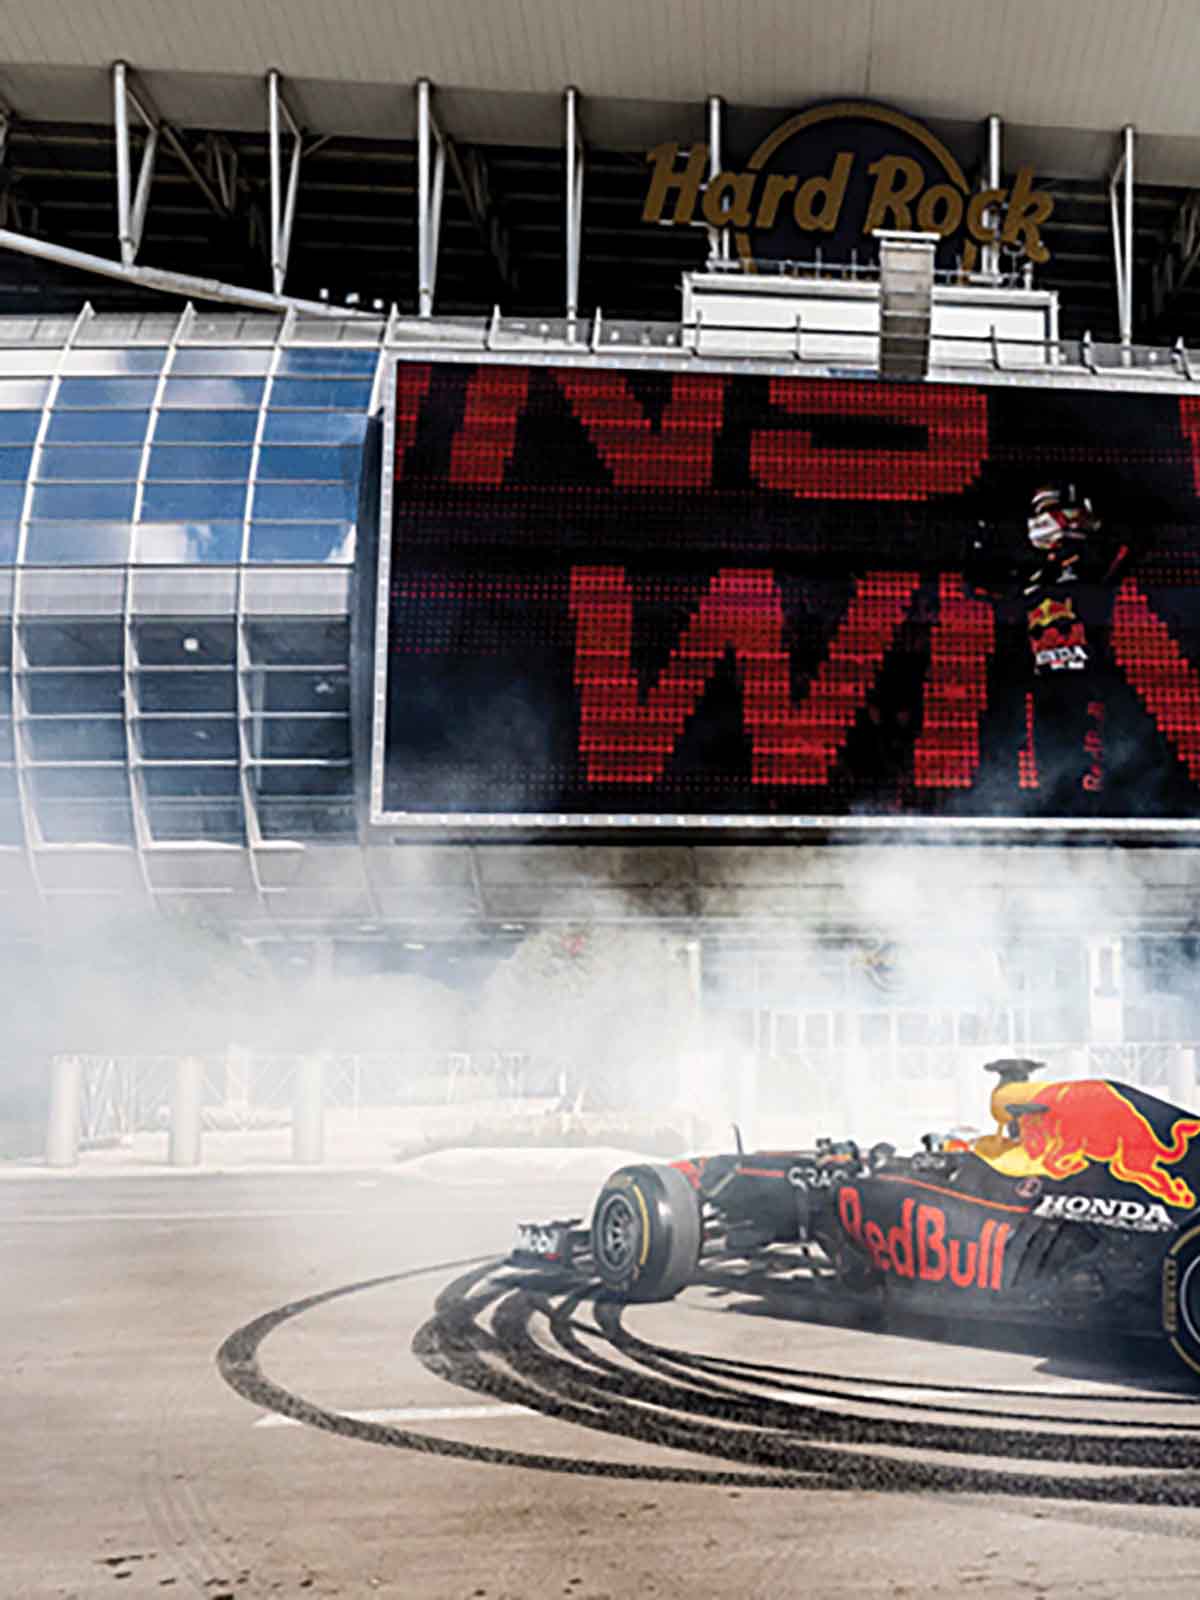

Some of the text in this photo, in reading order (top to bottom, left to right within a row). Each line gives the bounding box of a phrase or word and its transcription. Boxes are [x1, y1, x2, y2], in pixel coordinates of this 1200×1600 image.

[642, 141, 1055, 263] Hard Rock
[1033, 1195, 1174, 1226] HONDA
